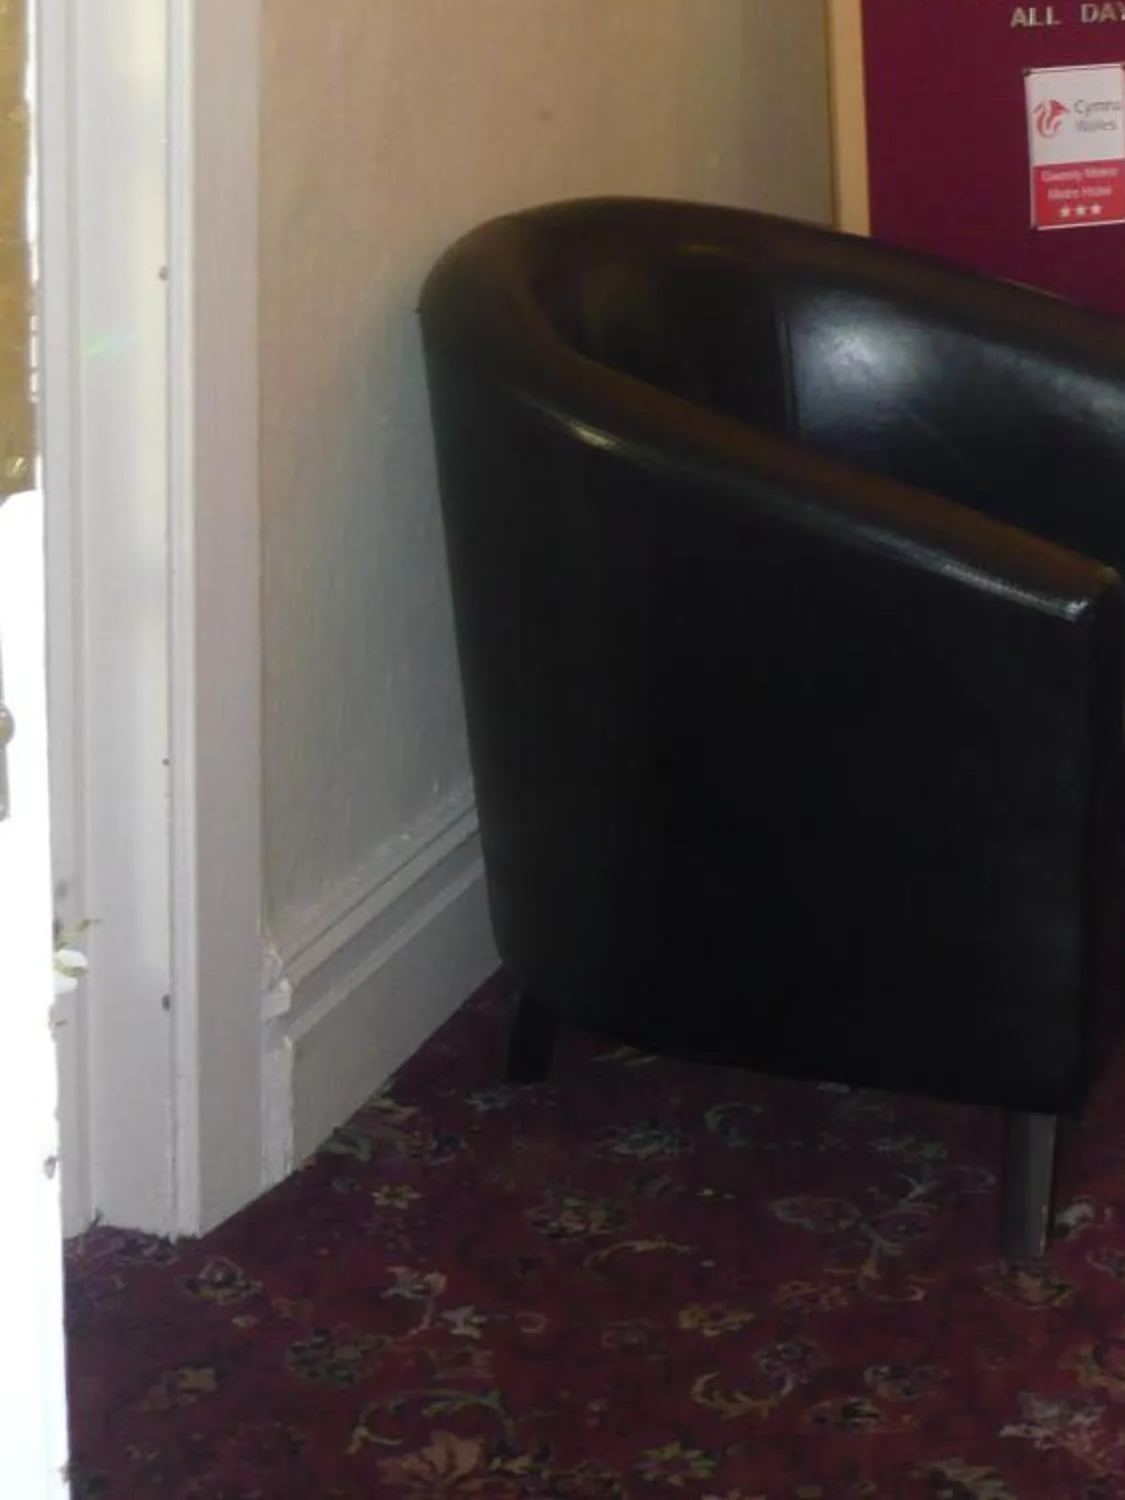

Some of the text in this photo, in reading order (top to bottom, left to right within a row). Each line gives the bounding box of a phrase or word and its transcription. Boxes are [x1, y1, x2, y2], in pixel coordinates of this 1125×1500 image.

[1011, 6, 1061, 27] ALL
[1074, 99, 1122, 117] Cymru
[1074, 121, 1118, 132] Wales
